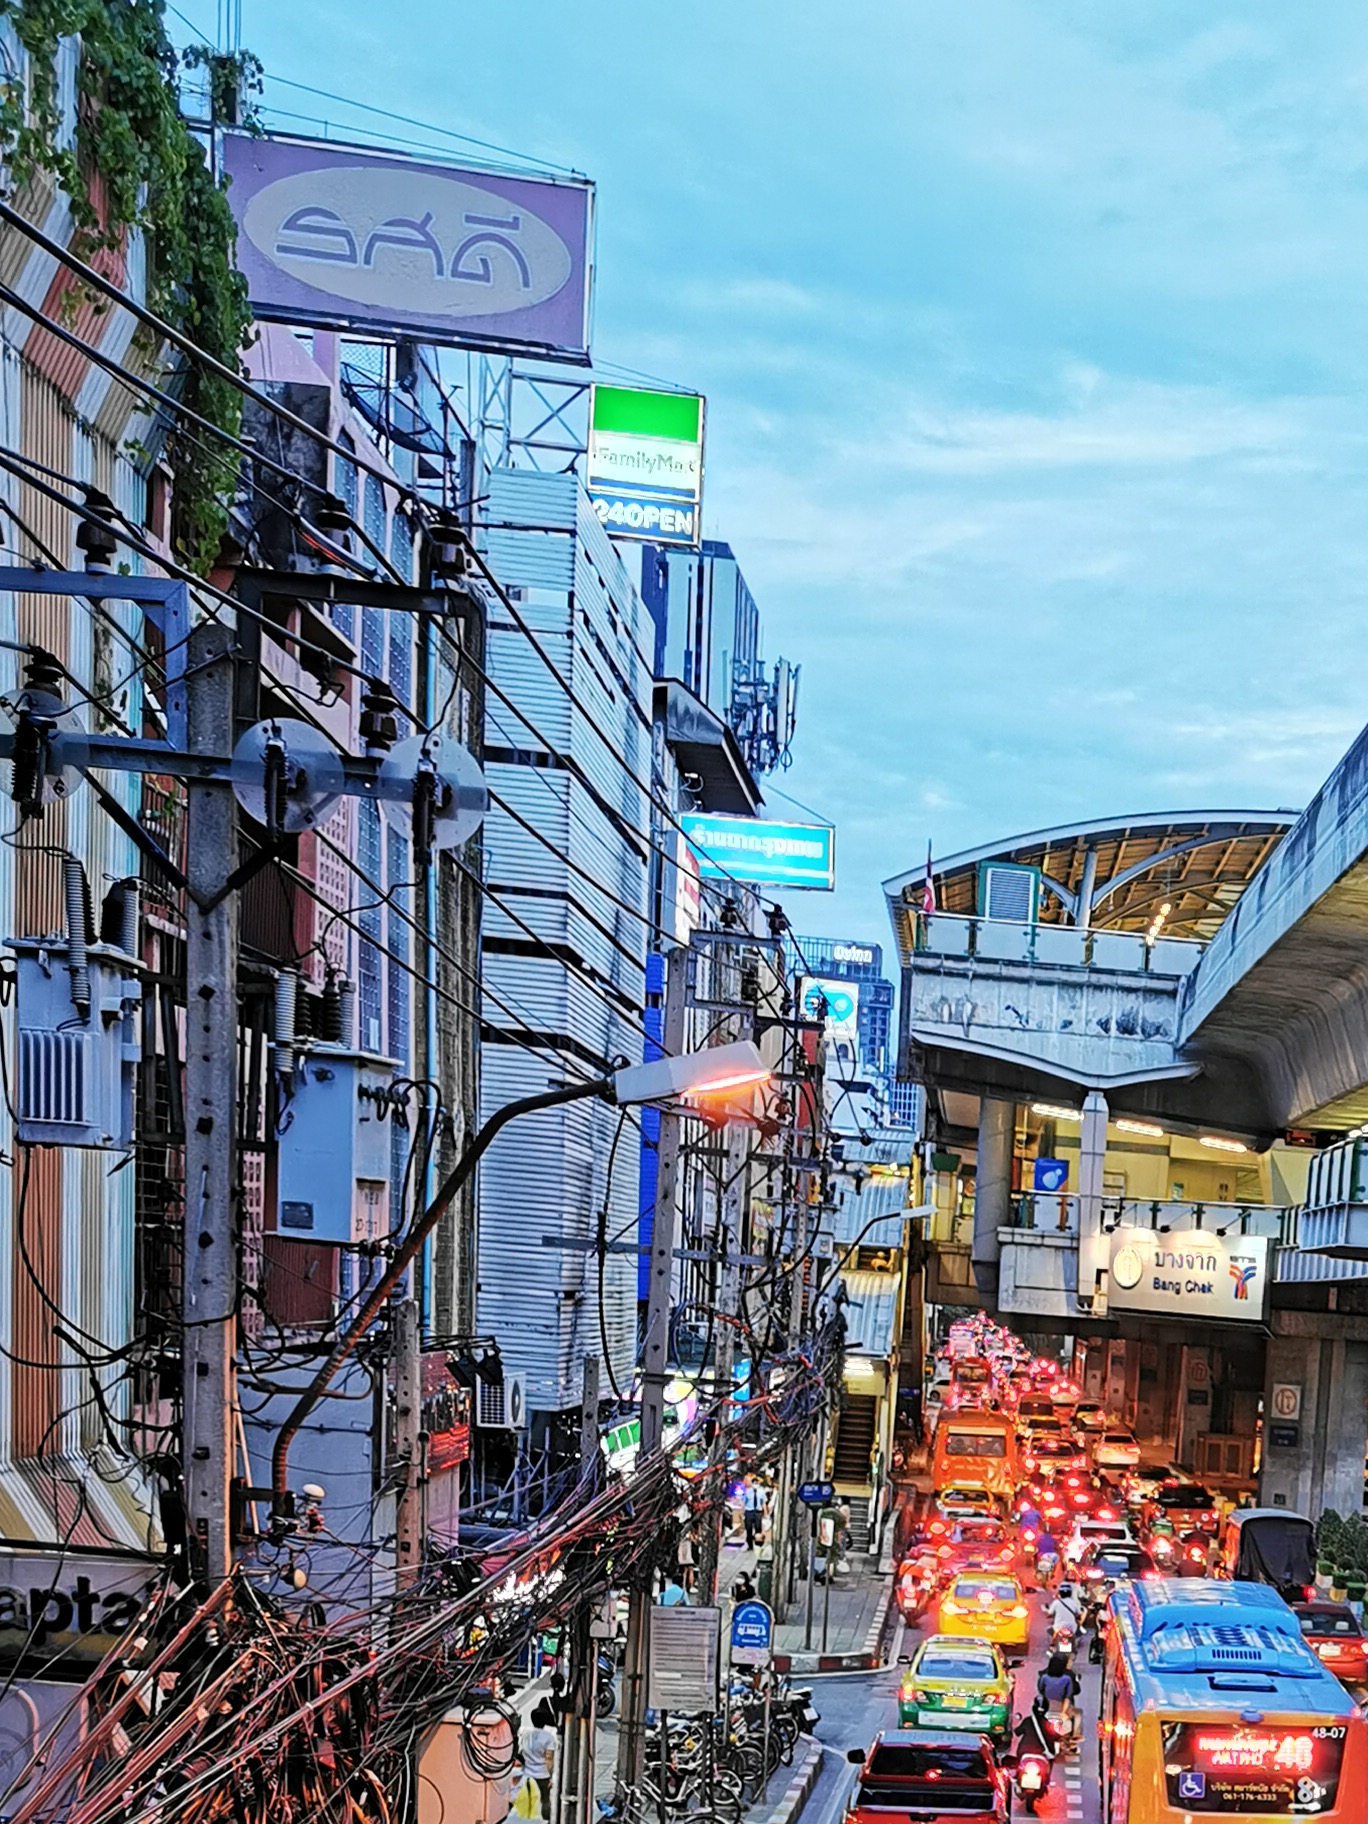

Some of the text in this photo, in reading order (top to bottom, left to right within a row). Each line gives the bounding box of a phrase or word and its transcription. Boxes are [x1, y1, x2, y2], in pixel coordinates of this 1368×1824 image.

[1154, 1251, 1218, 1272] บางจาก
[1152, 1277, 1215, 1295] Bang Chak
[1312, 1727, 1346, 1740] 48-07
